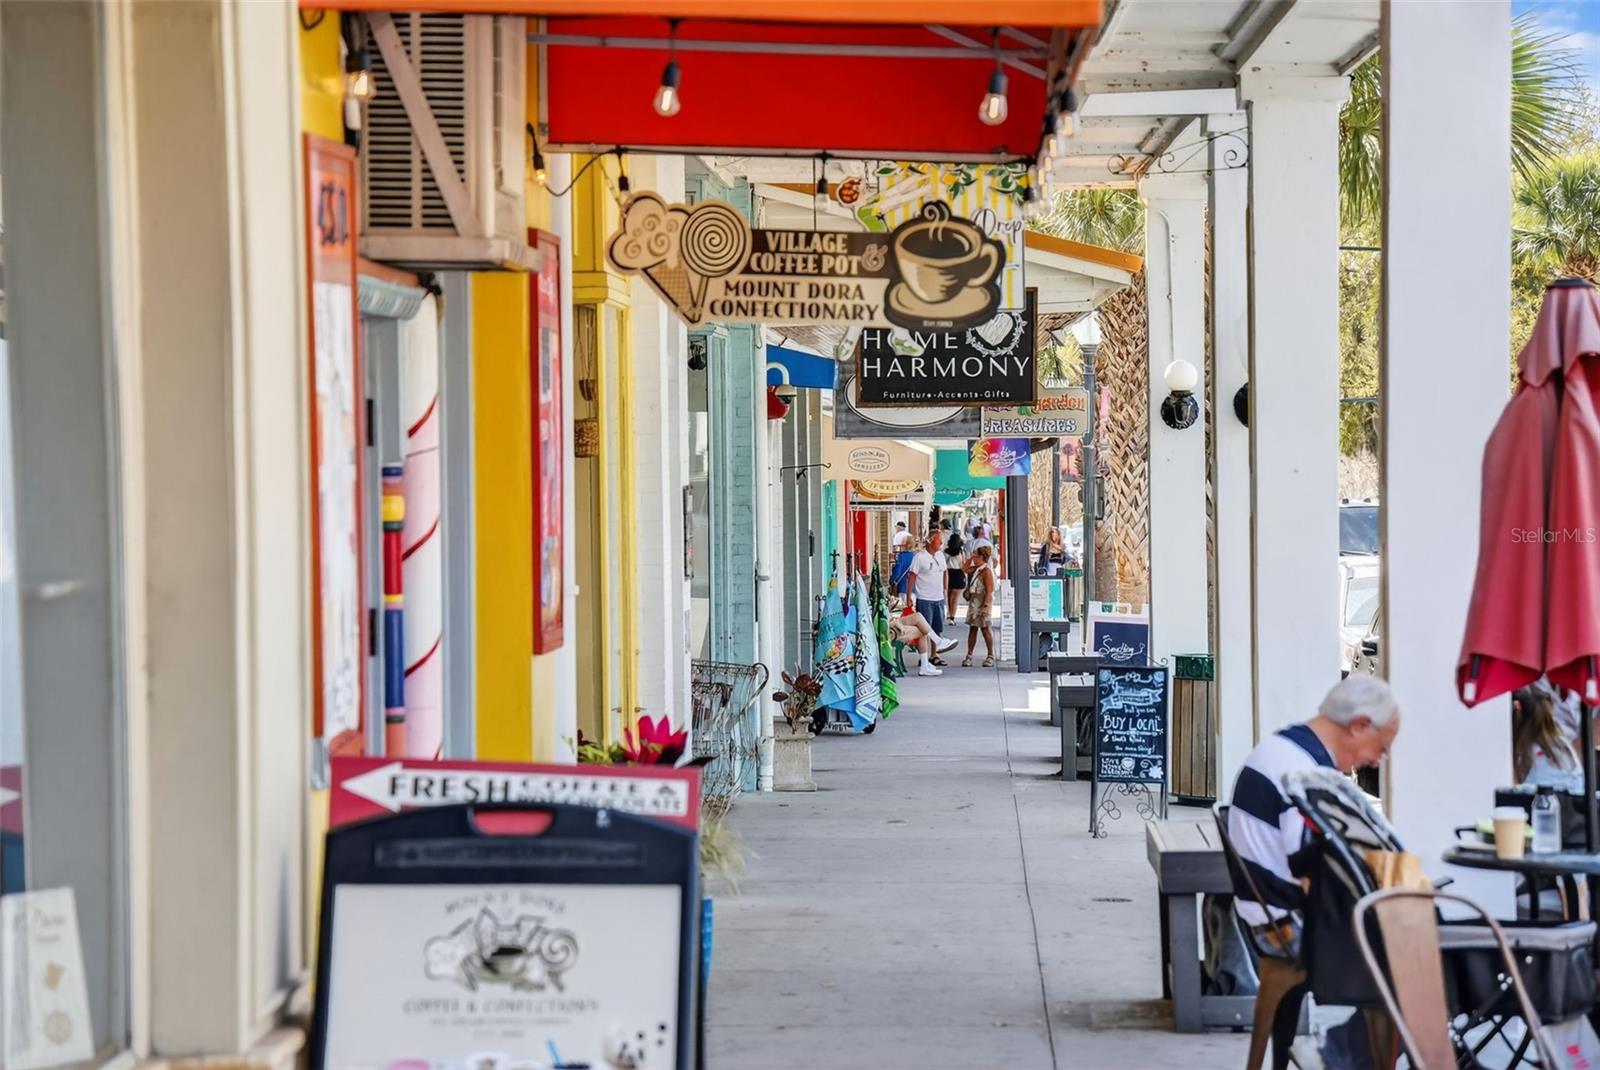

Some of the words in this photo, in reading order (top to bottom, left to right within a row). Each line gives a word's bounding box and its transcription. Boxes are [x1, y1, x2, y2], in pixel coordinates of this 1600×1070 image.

[971, 208, 1022, 244] Drop
[766, 231, 848, 254] VILLAGE
[750, 252, 819, 274] COFFEE
[821, 254, 861, 276] POT
[861, 243, 888, 272] &
[724, 279, 800, 298] MOUNT
[808, 282, 865, 300] DORA
[709, 299, 879, 321] CONFECTIONARY
[863, 330, 958, 350] HME
[863, 356, 1030, 378] HARMONY
[1103, 714, 1126, 729] BUY
[1129, 717, 1160, 732] LOCAL
[388, 773, 511, 802] FRESH
[521, 778, 640, 795] COFFEE
